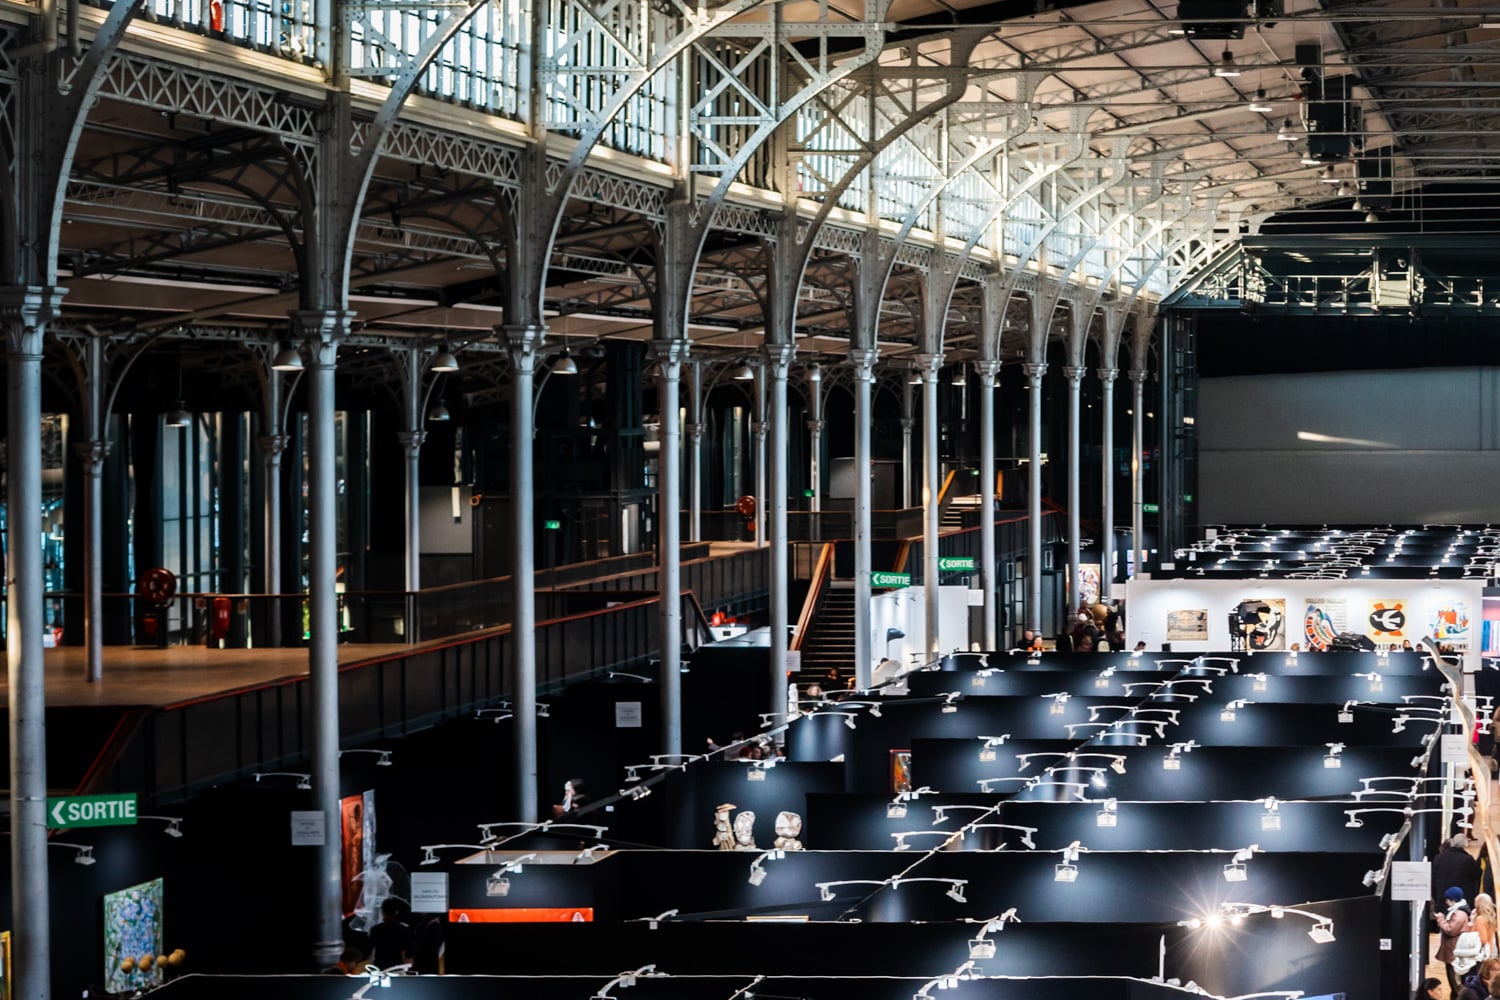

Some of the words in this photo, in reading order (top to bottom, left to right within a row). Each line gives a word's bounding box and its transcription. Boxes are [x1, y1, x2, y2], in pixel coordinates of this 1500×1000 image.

[945, 559, 974, 568] SORTIE
[879, 575, 911, 585] SORTIE
[68, 800, 136, 821] SORTIE
